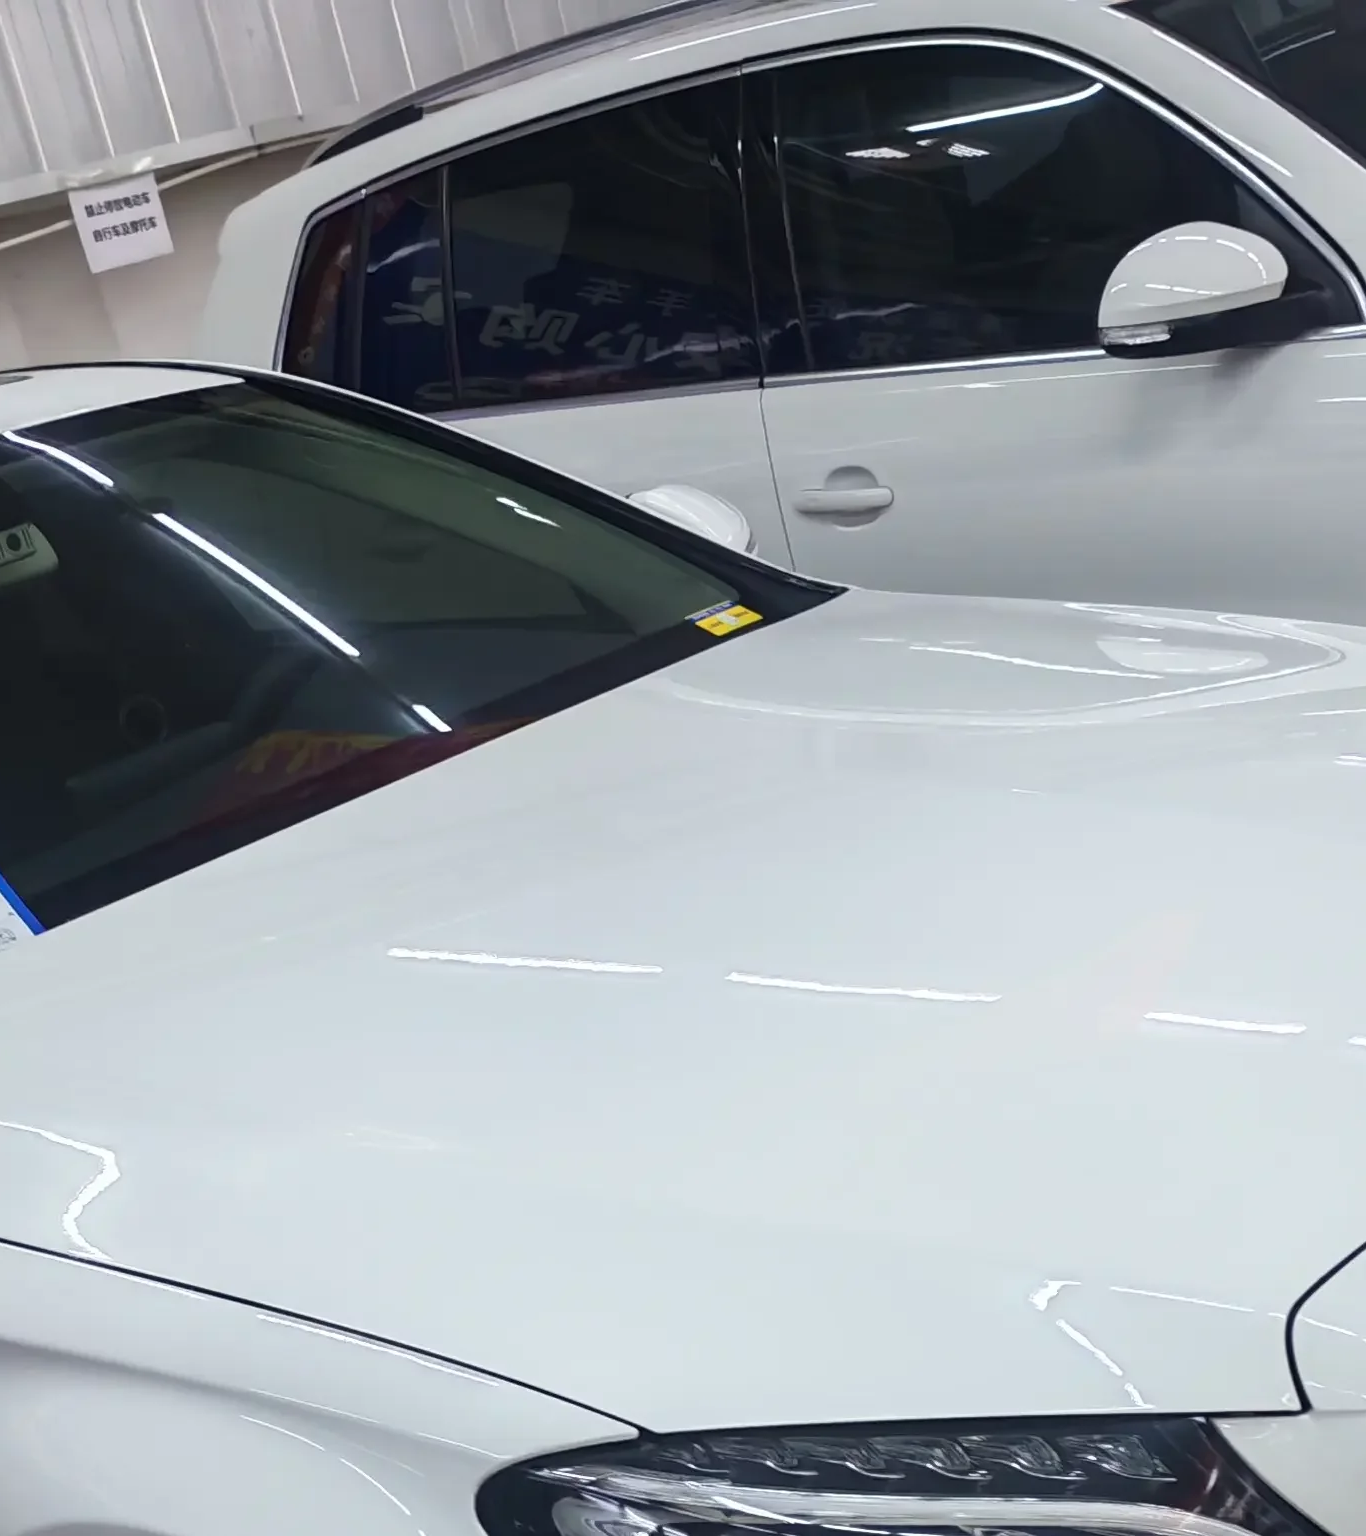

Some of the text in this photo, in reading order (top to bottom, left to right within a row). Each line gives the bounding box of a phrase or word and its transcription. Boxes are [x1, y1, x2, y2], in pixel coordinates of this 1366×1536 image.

[92, 216, 157, 243] 自行车及摩托车
